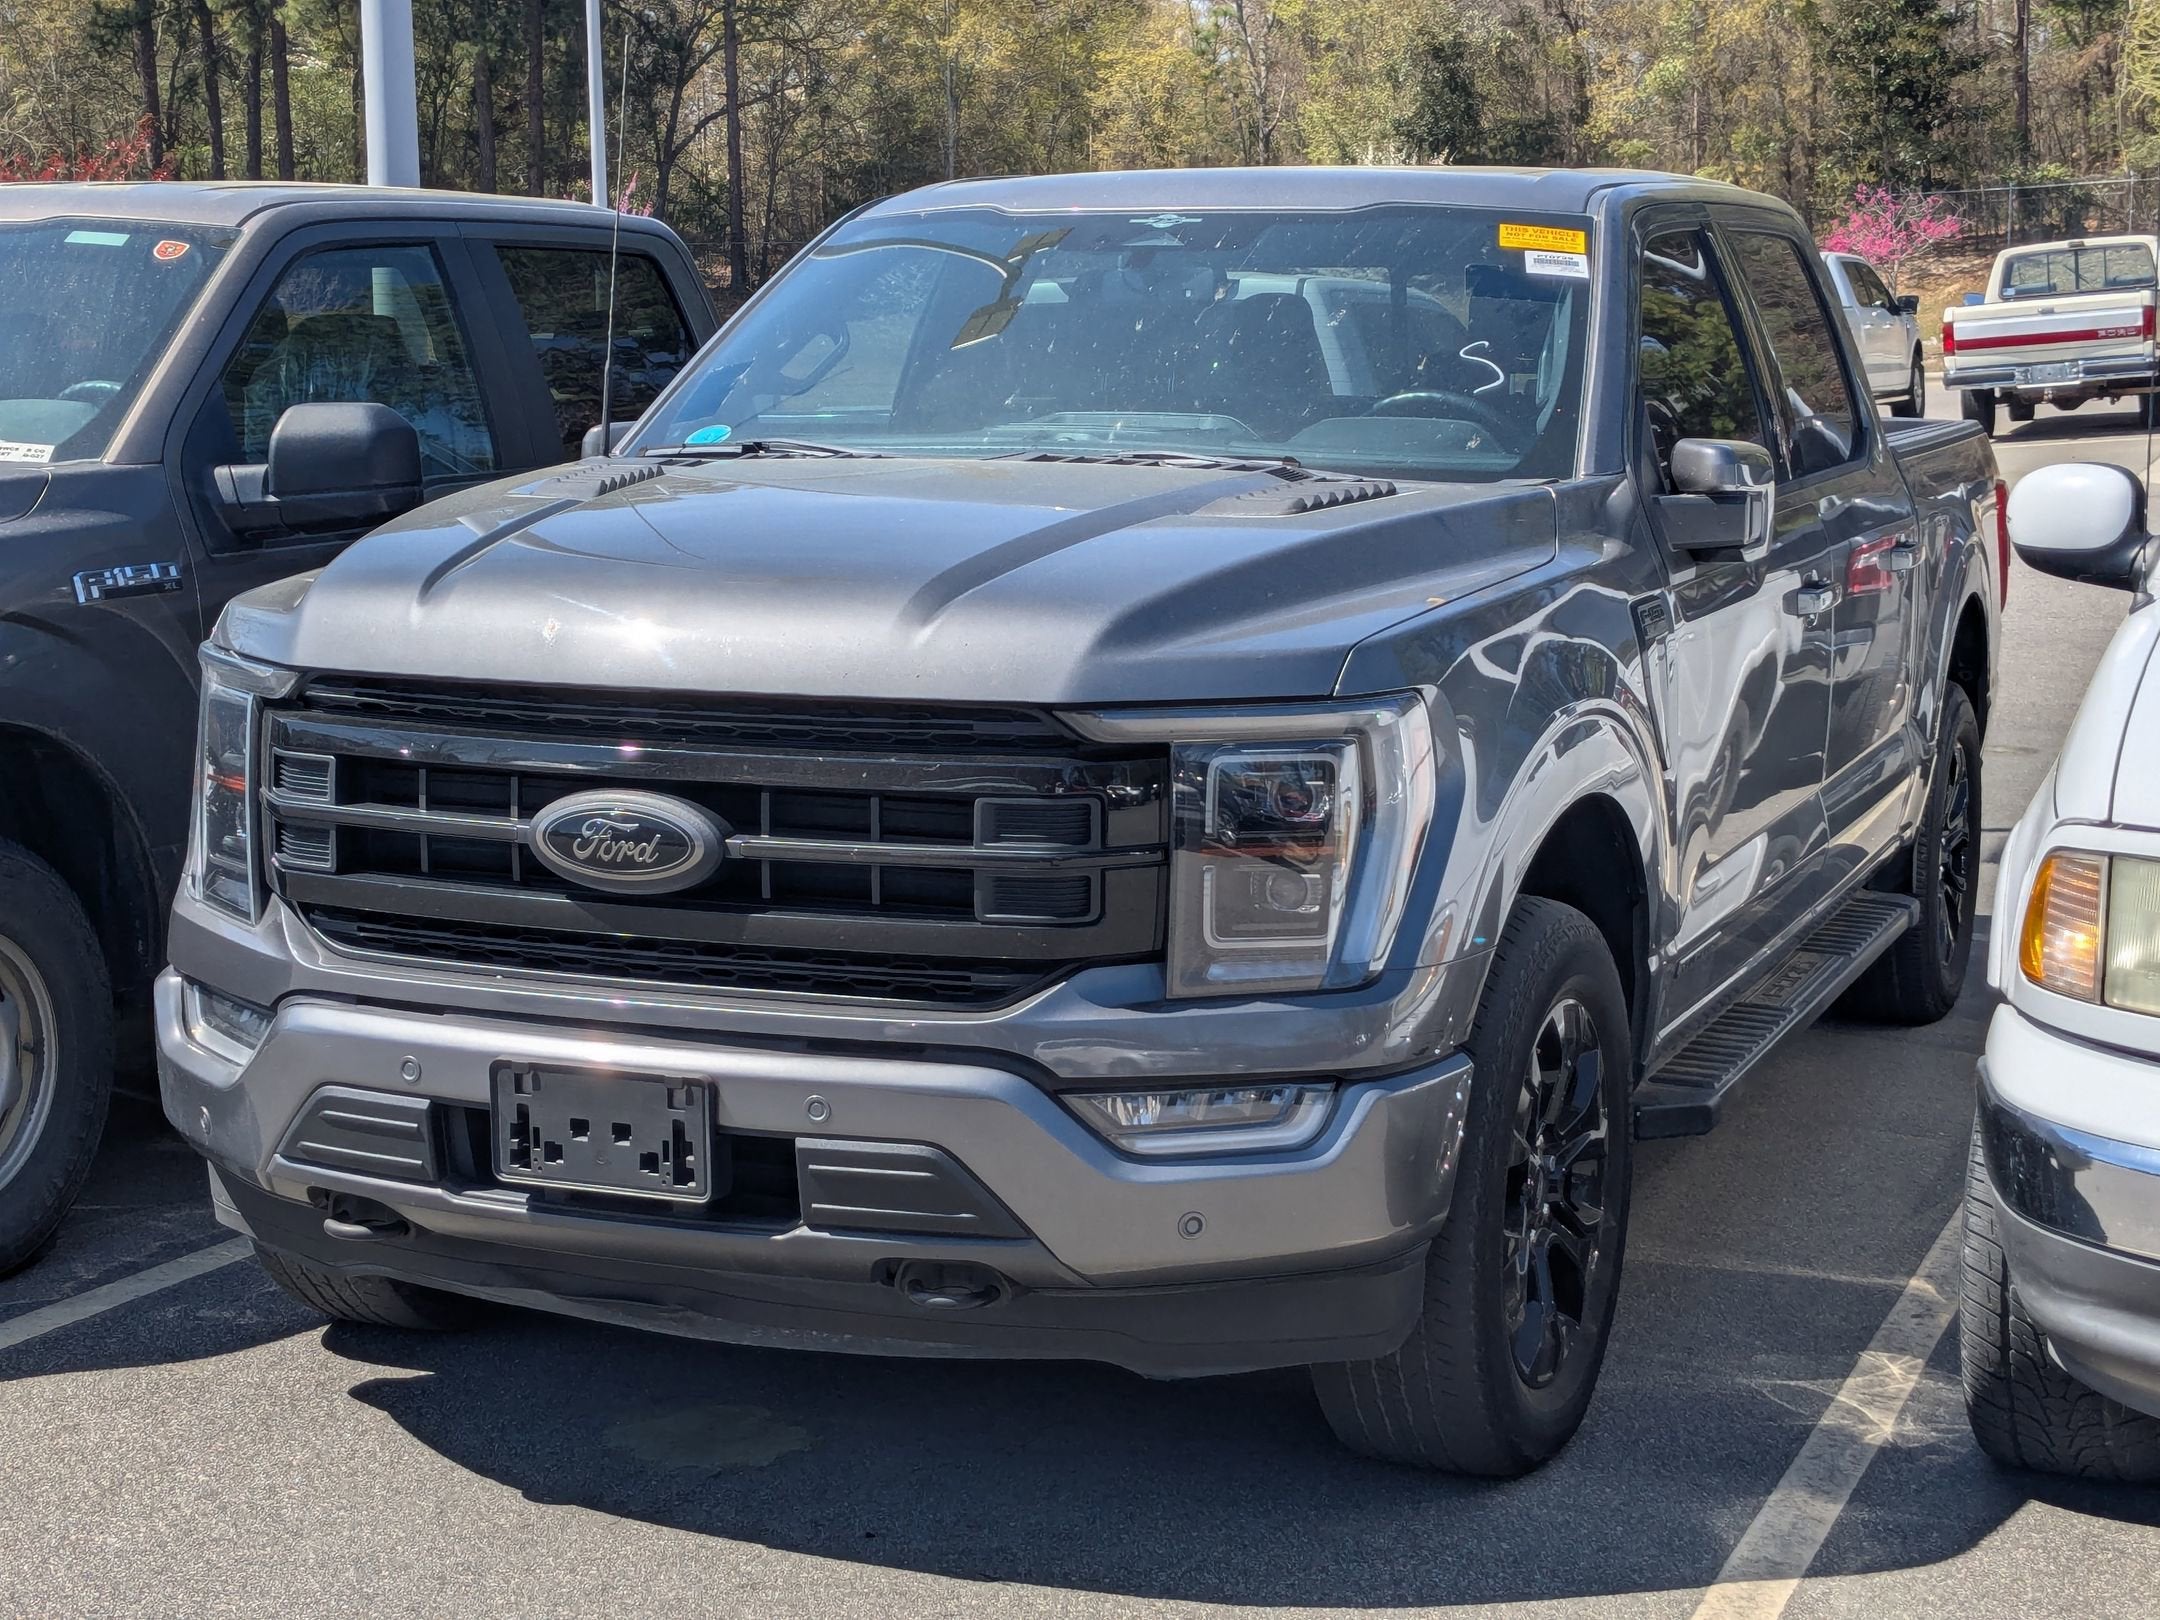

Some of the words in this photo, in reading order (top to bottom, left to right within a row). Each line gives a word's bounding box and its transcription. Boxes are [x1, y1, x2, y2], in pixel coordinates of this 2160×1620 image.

[1504, 225, 1528, 233] THIS
[1532, 227, 1579, 238] VEHICLE
[2097, 327, 2137, 338] FORD
[164, 582, 180, 590] XL
[572, 818, 662, 864] Ford
